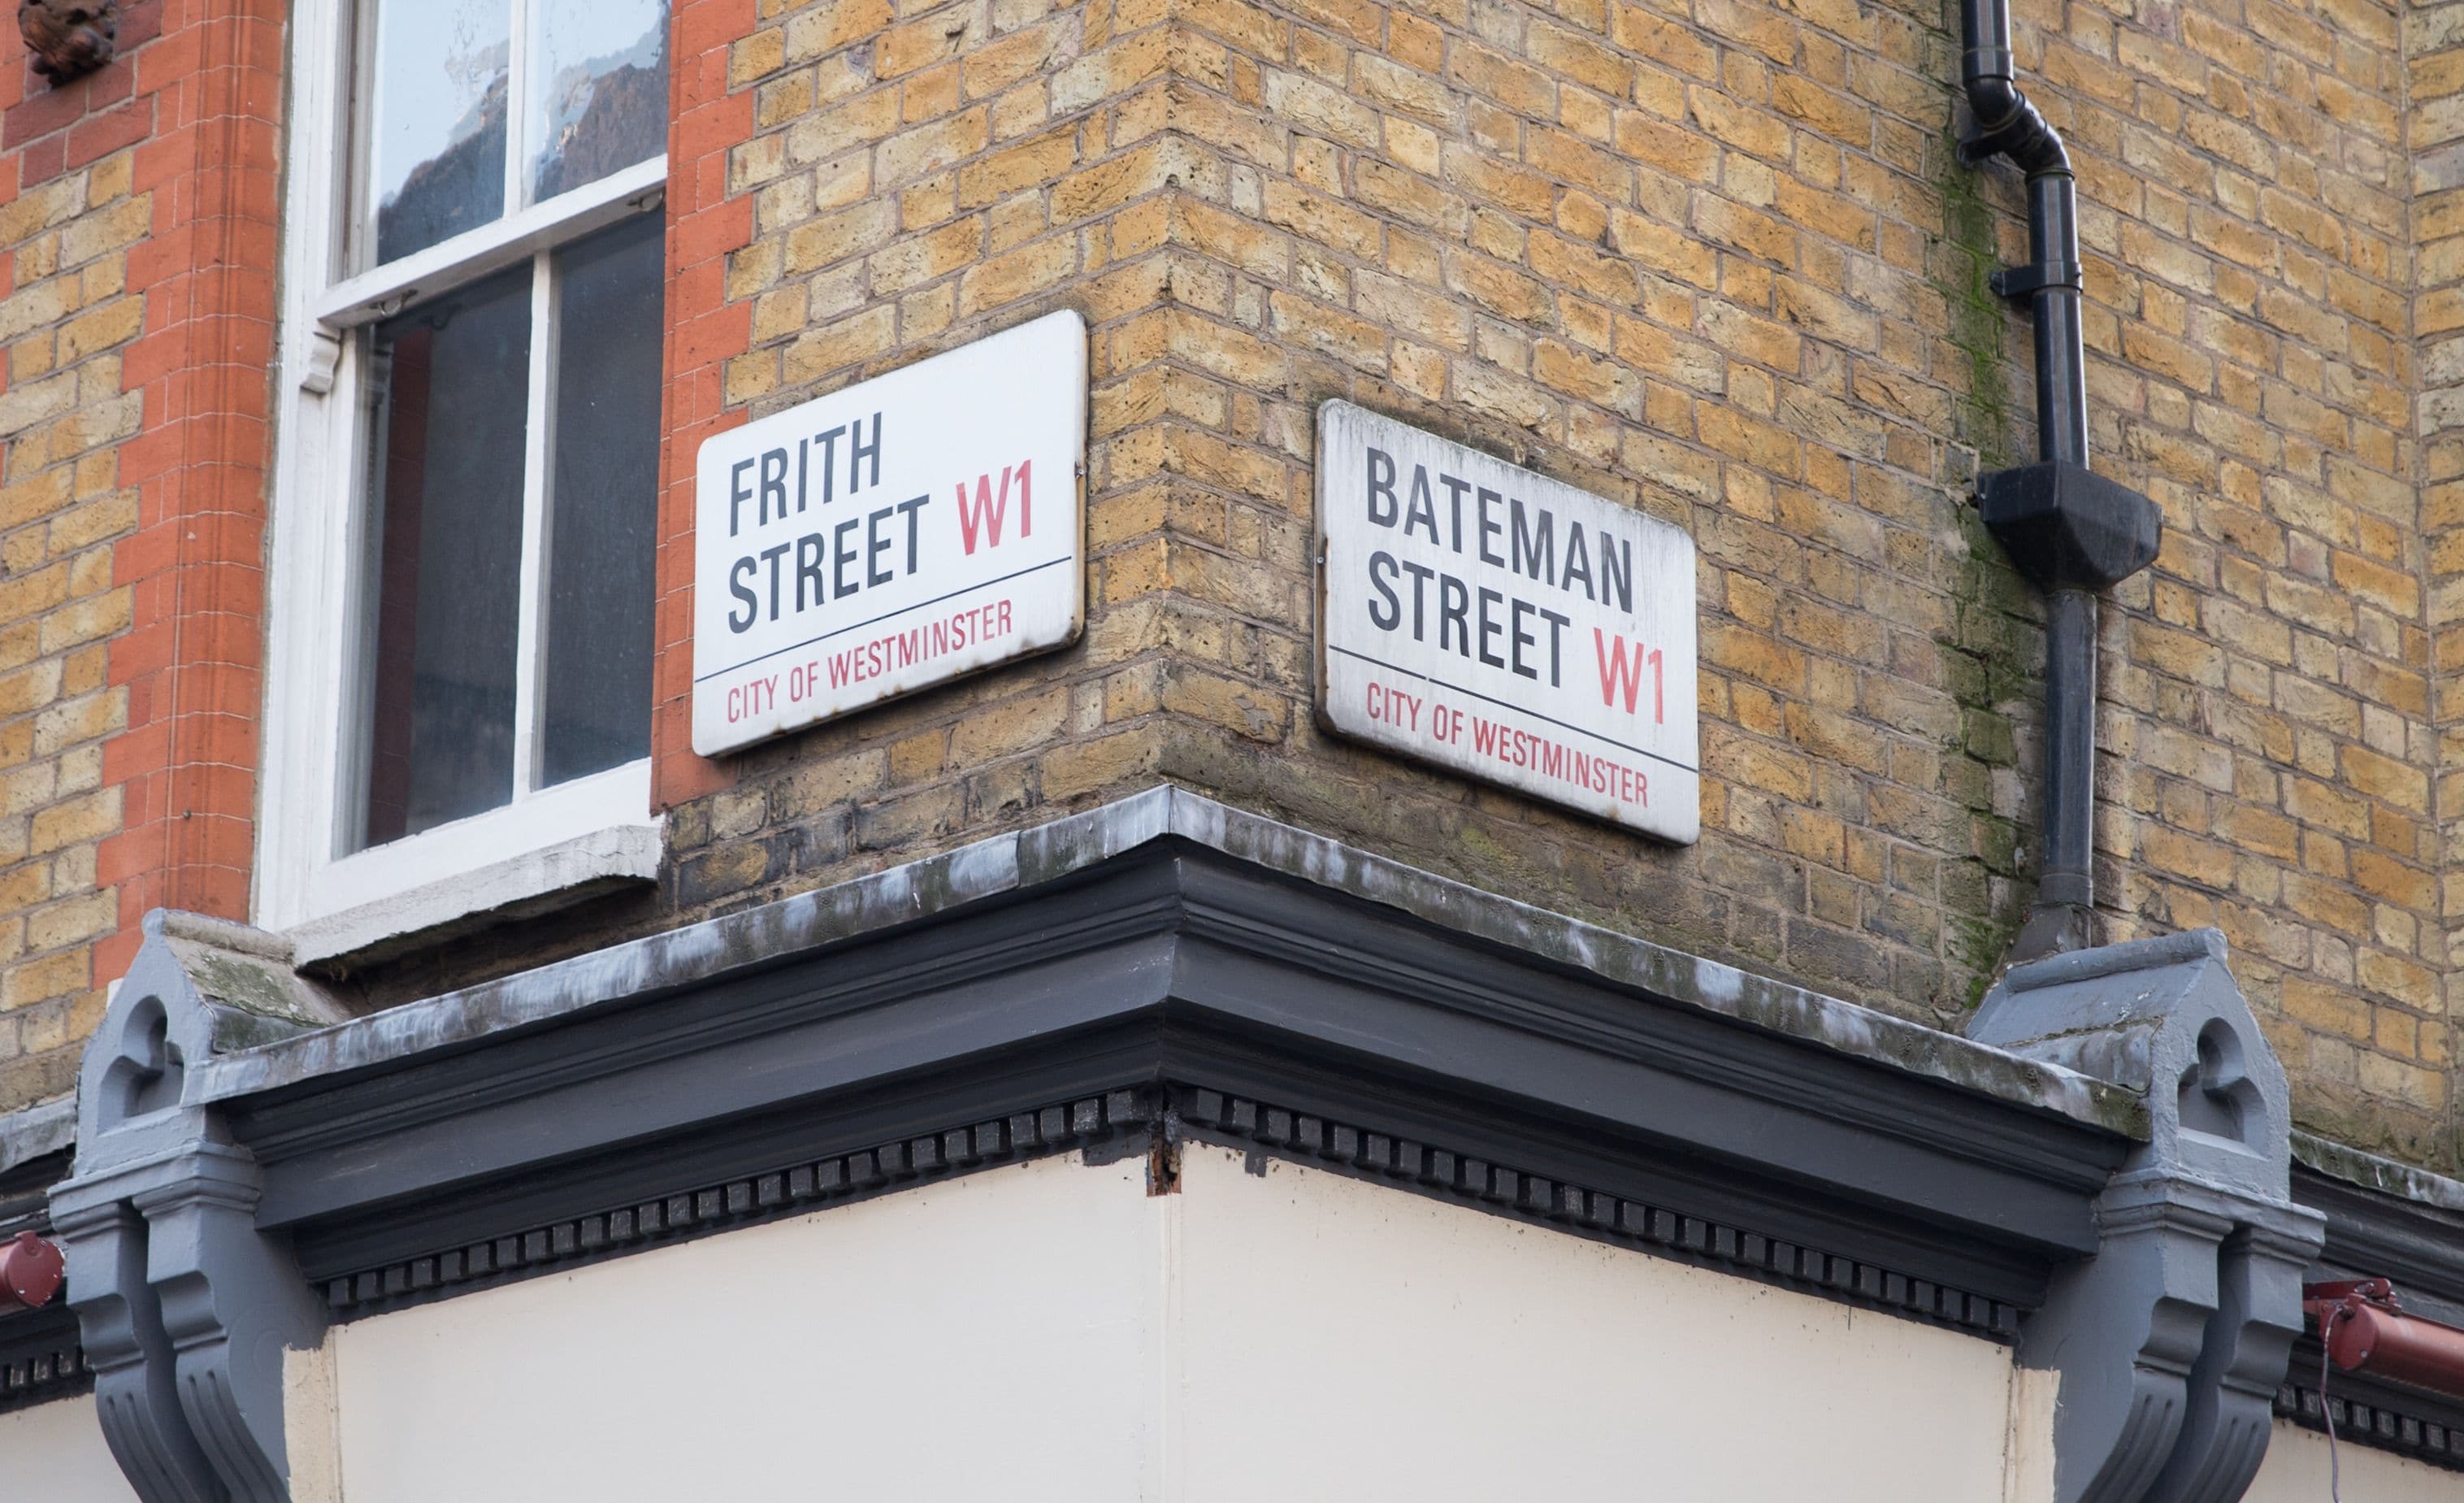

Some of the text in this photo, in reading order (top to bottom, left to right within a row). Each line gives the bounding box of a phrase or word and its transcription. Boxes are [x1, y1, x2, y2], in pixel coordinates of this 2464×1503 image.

[728, 458, 1031, 634] STREET W1
[730, 411, 882, 537] FRITH
[1367, 446, 1633, 615] BATEMAN
[727, 599, 1013, 723] CITY OF WESTMINSTER
[1368, 550, 1664, 725] STREET W1
[1367, 682, 1648, 808] CITY OF WESTMINSTER
